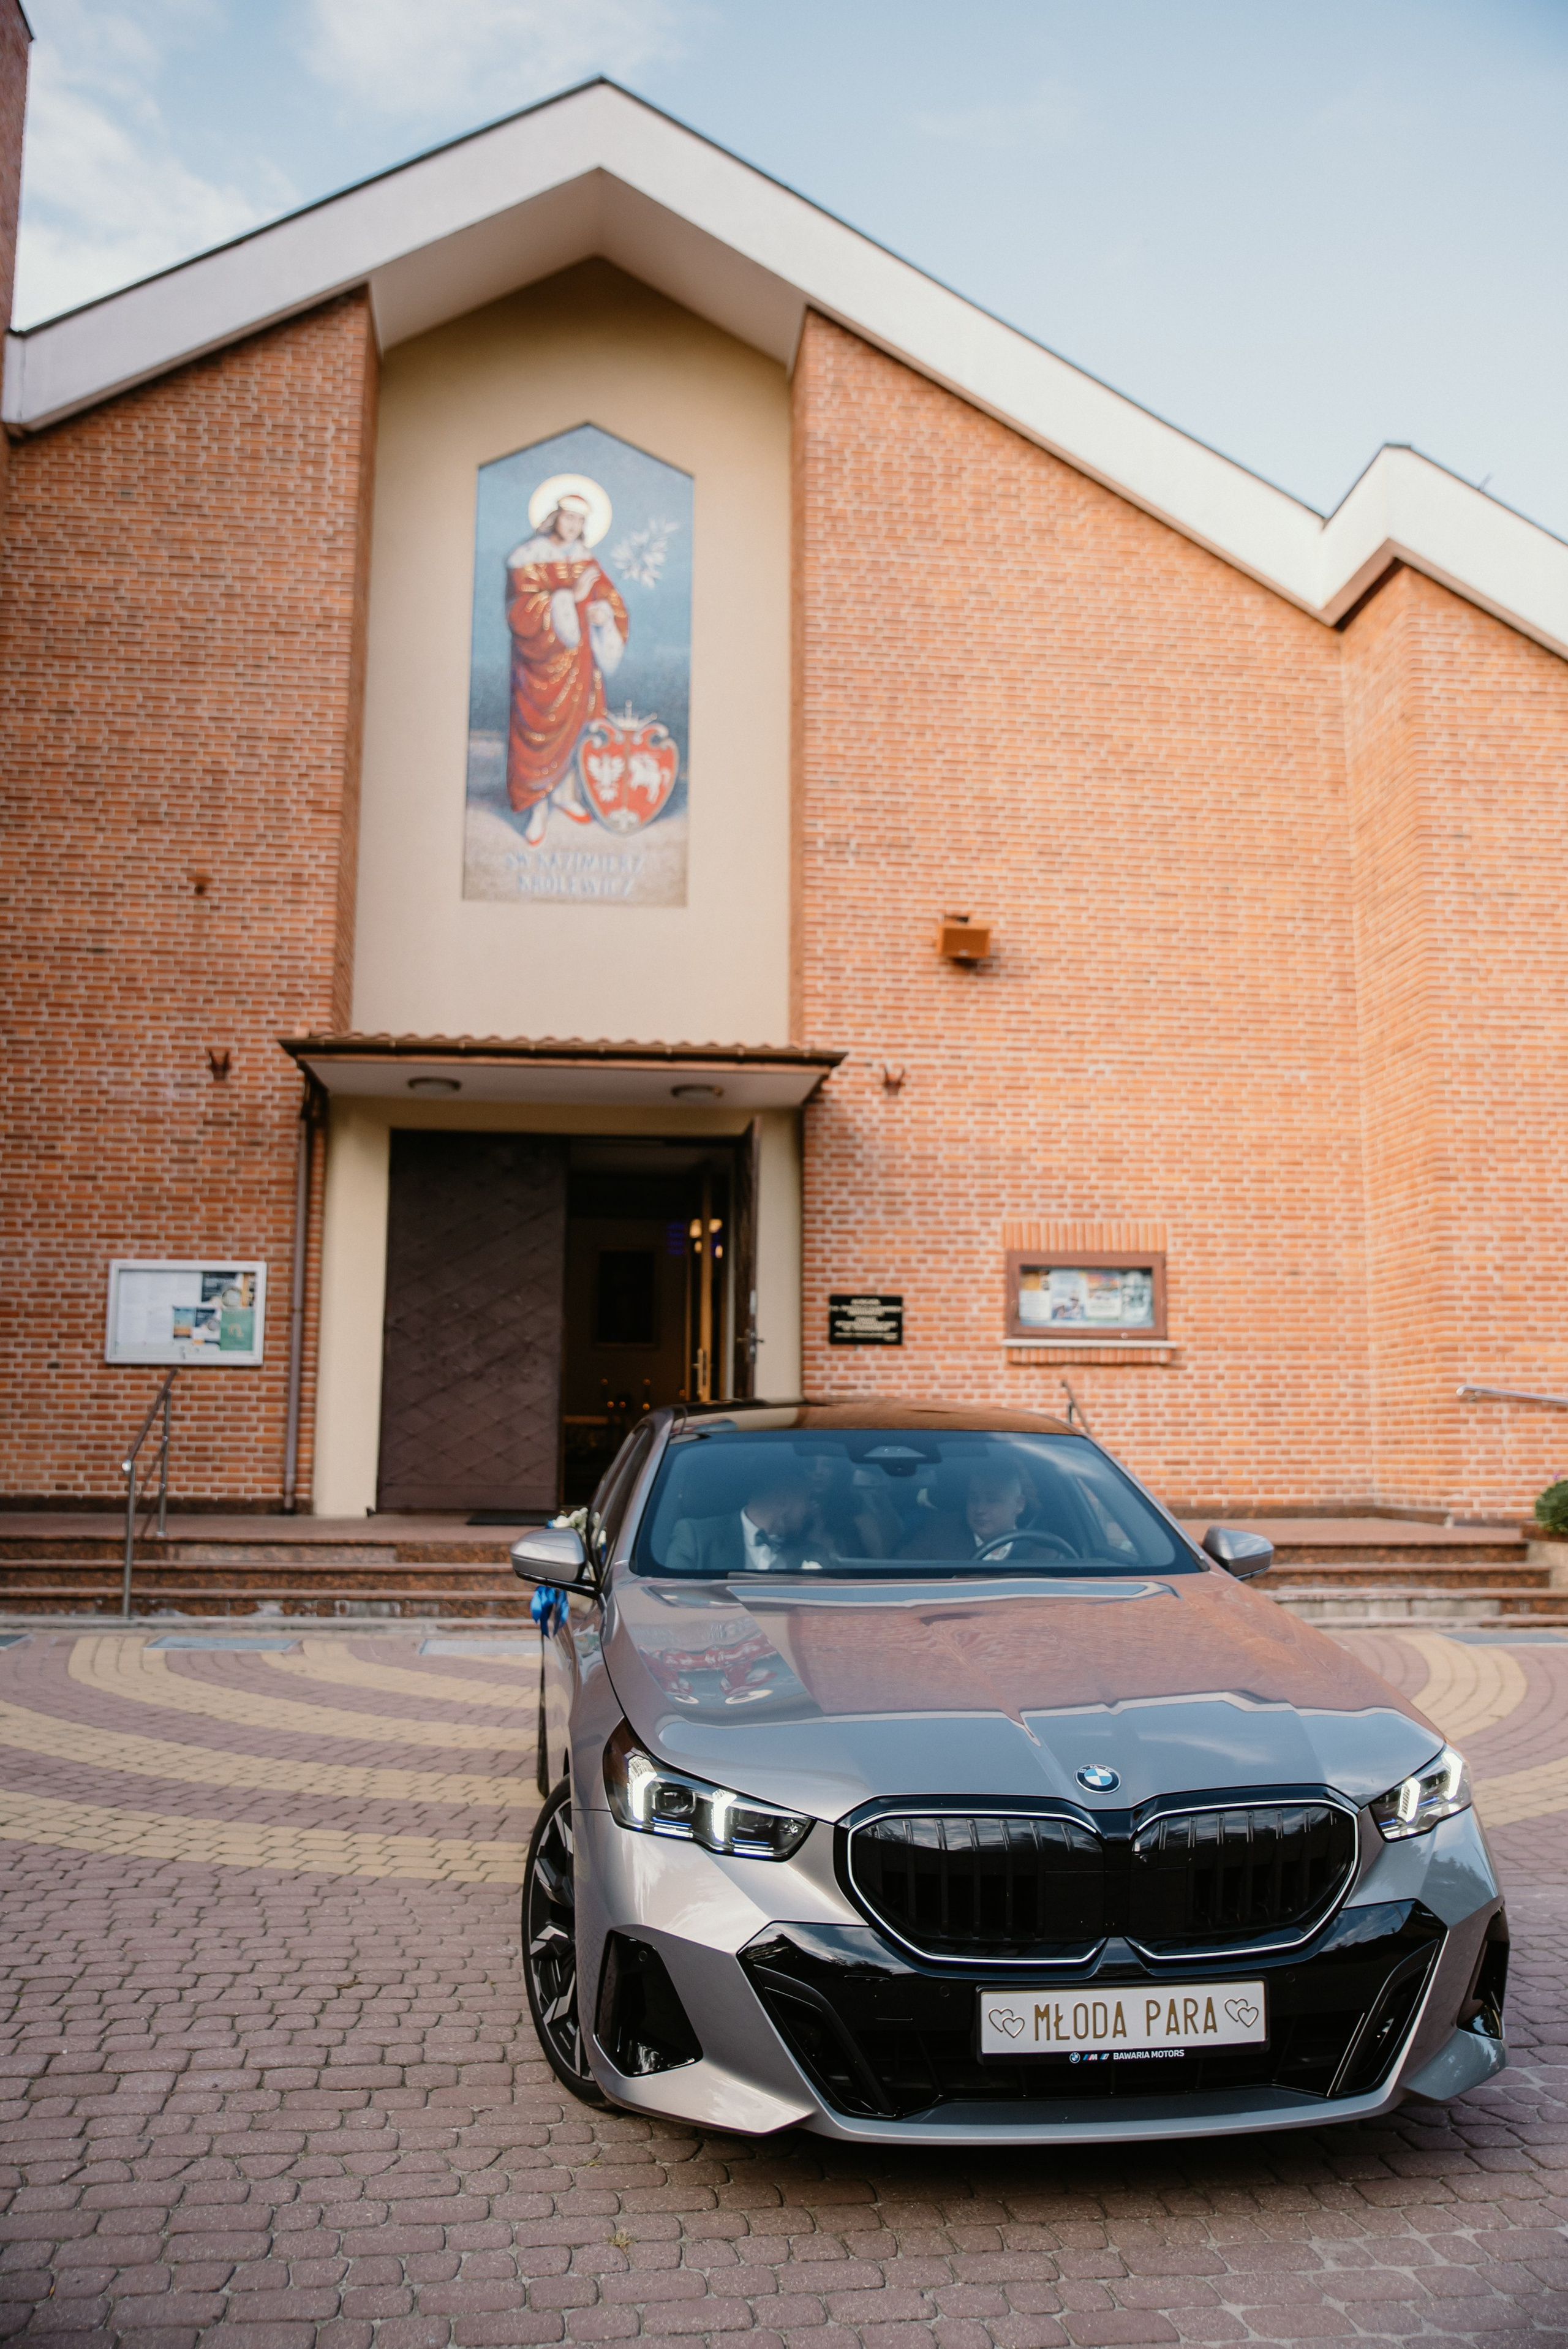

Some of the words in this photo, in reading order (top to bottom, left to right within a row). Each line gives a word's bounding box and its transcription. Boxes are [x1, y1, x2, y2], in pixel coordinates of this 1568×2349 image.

[1035, 2001, 1127, 2041] MŁODA
[1145, 1996, 1218, 2037] PARA
[1150, 2049, 1185, 2058] MOTORS
